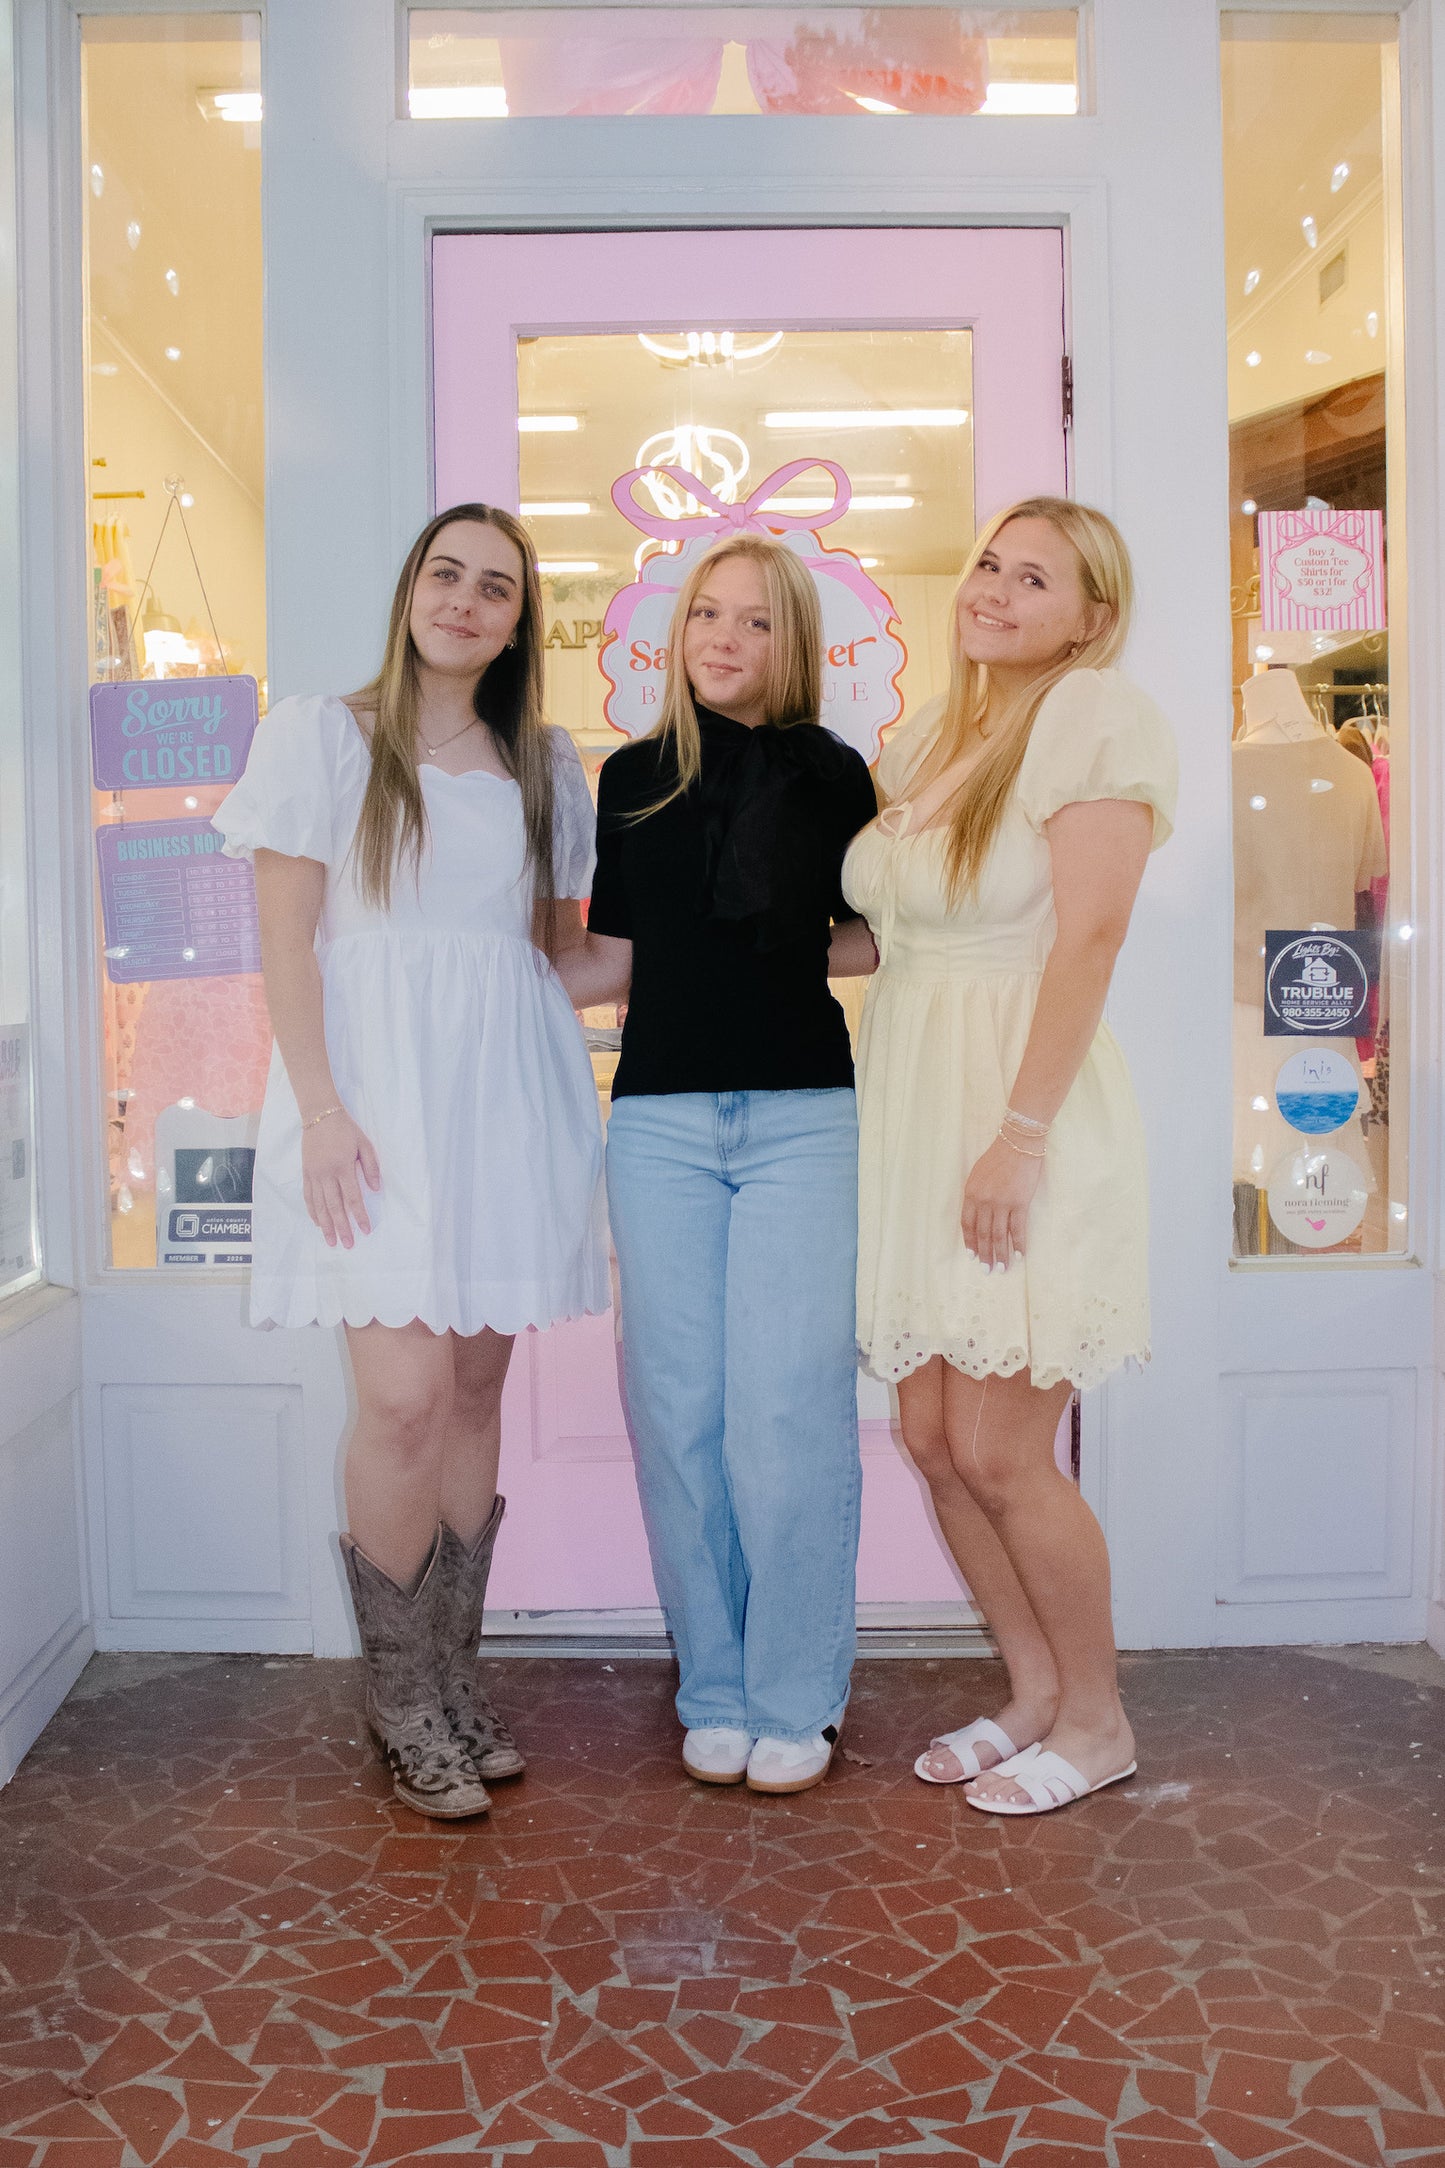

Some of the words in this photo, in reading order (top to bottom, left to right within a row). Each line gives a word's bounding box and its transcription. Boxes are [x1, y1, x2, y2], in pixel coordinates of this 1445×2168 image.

[1308, 548, 1326, 558] Buy
[1330, 548, 1335, 556] 2
[1294, 558, 1329, 566] Custom
[1332, 557, 1349, 566] Tee
[1300, 568, 1328, 576] Shirts
[1330, 567, 1343, 576] for
[1332, 577, 1346, 586] for
[121, 688, 228, 737] Sorry
[156, 731, 193, 745] WE'RE
[122, 744, 232, 782] CLOSED
[117, 836, 192, 862] BUSINESS
[1292, 944, 1321, 957] Lights
[1281, 987, 1354, 1000] TRUBLUE
[1282, 1008, 1350, 1017] 980-355-2450
[1303, 1060, 1332, 1080] inis
[1306, 1164, 1328, 1195] nf
[202, 1224, 250, 1234] CHAMBER
